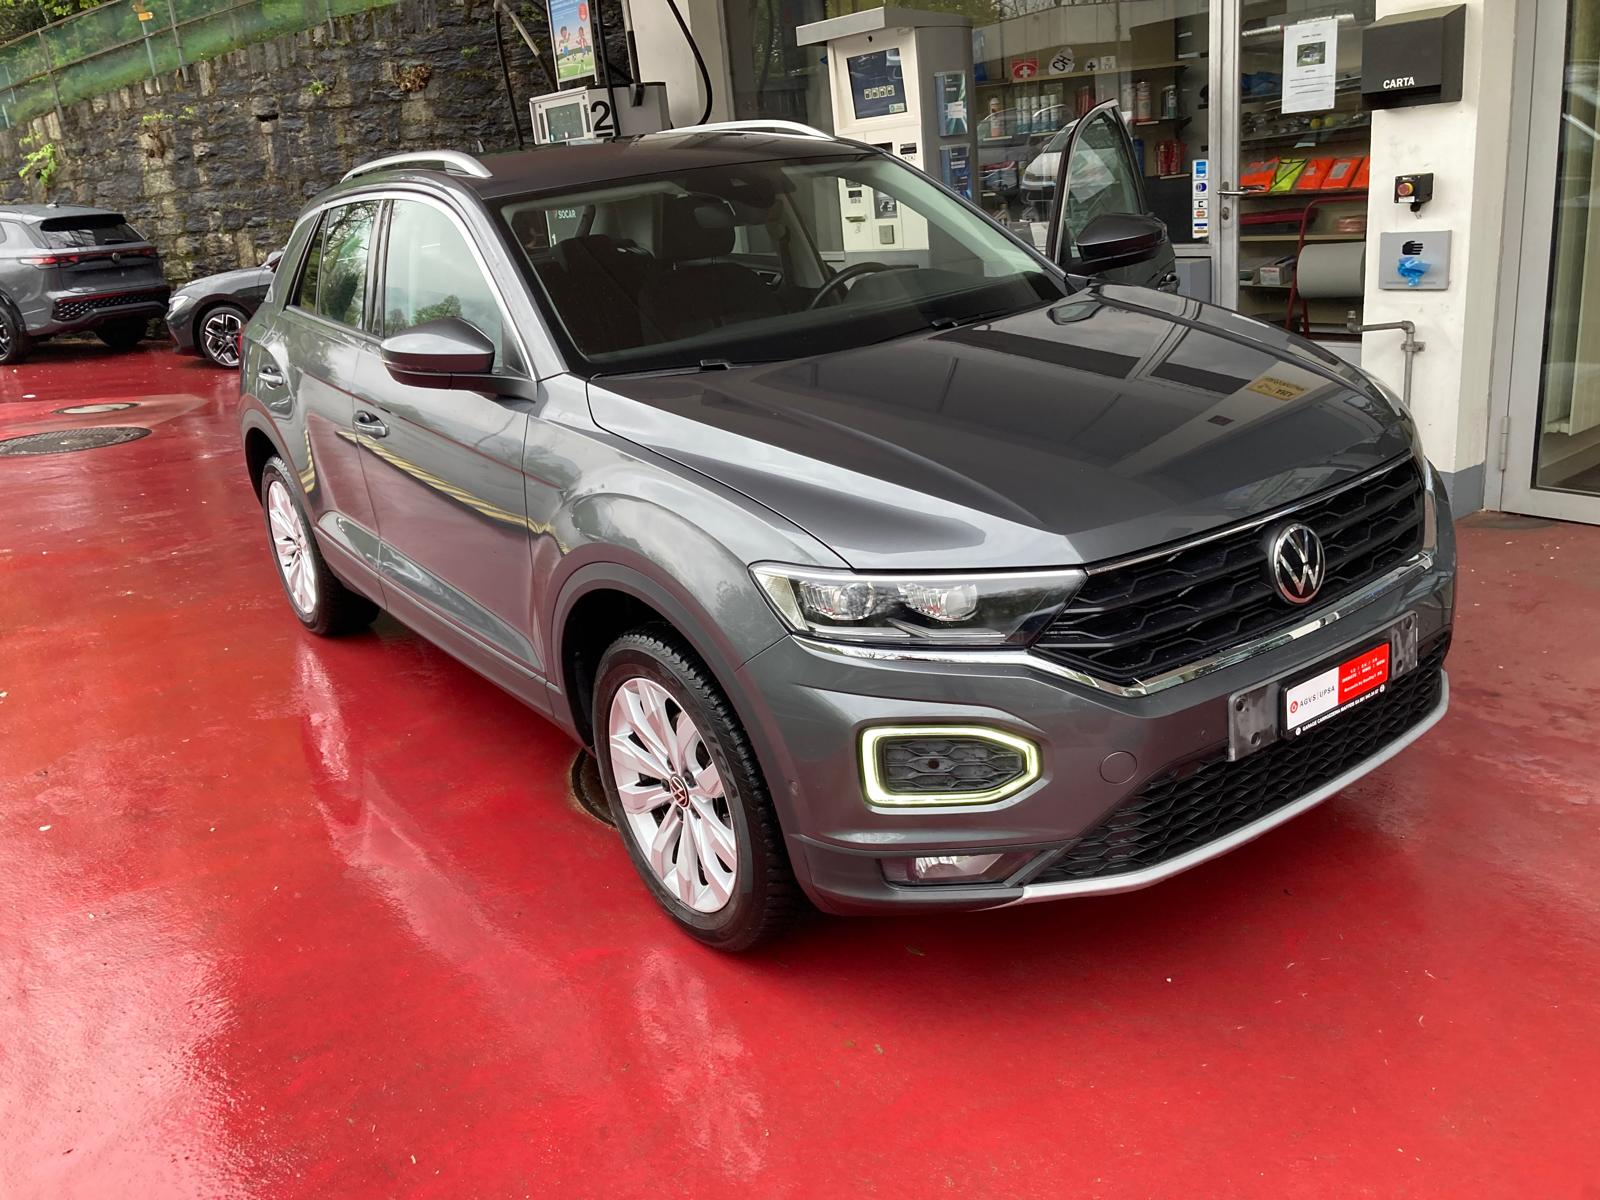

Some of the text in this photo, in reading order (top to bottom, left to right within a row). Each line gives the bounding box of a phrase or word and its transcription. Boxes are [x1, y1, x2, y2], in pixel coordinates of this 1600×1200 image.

[1052, 54, 1071, 72] CH
[1382, 76, 1415, 90] CARTA
[590, 100, 614, 132] 2
[558, 209, 577, 219] SOCAR
[551, 233, 557, 245] 1
